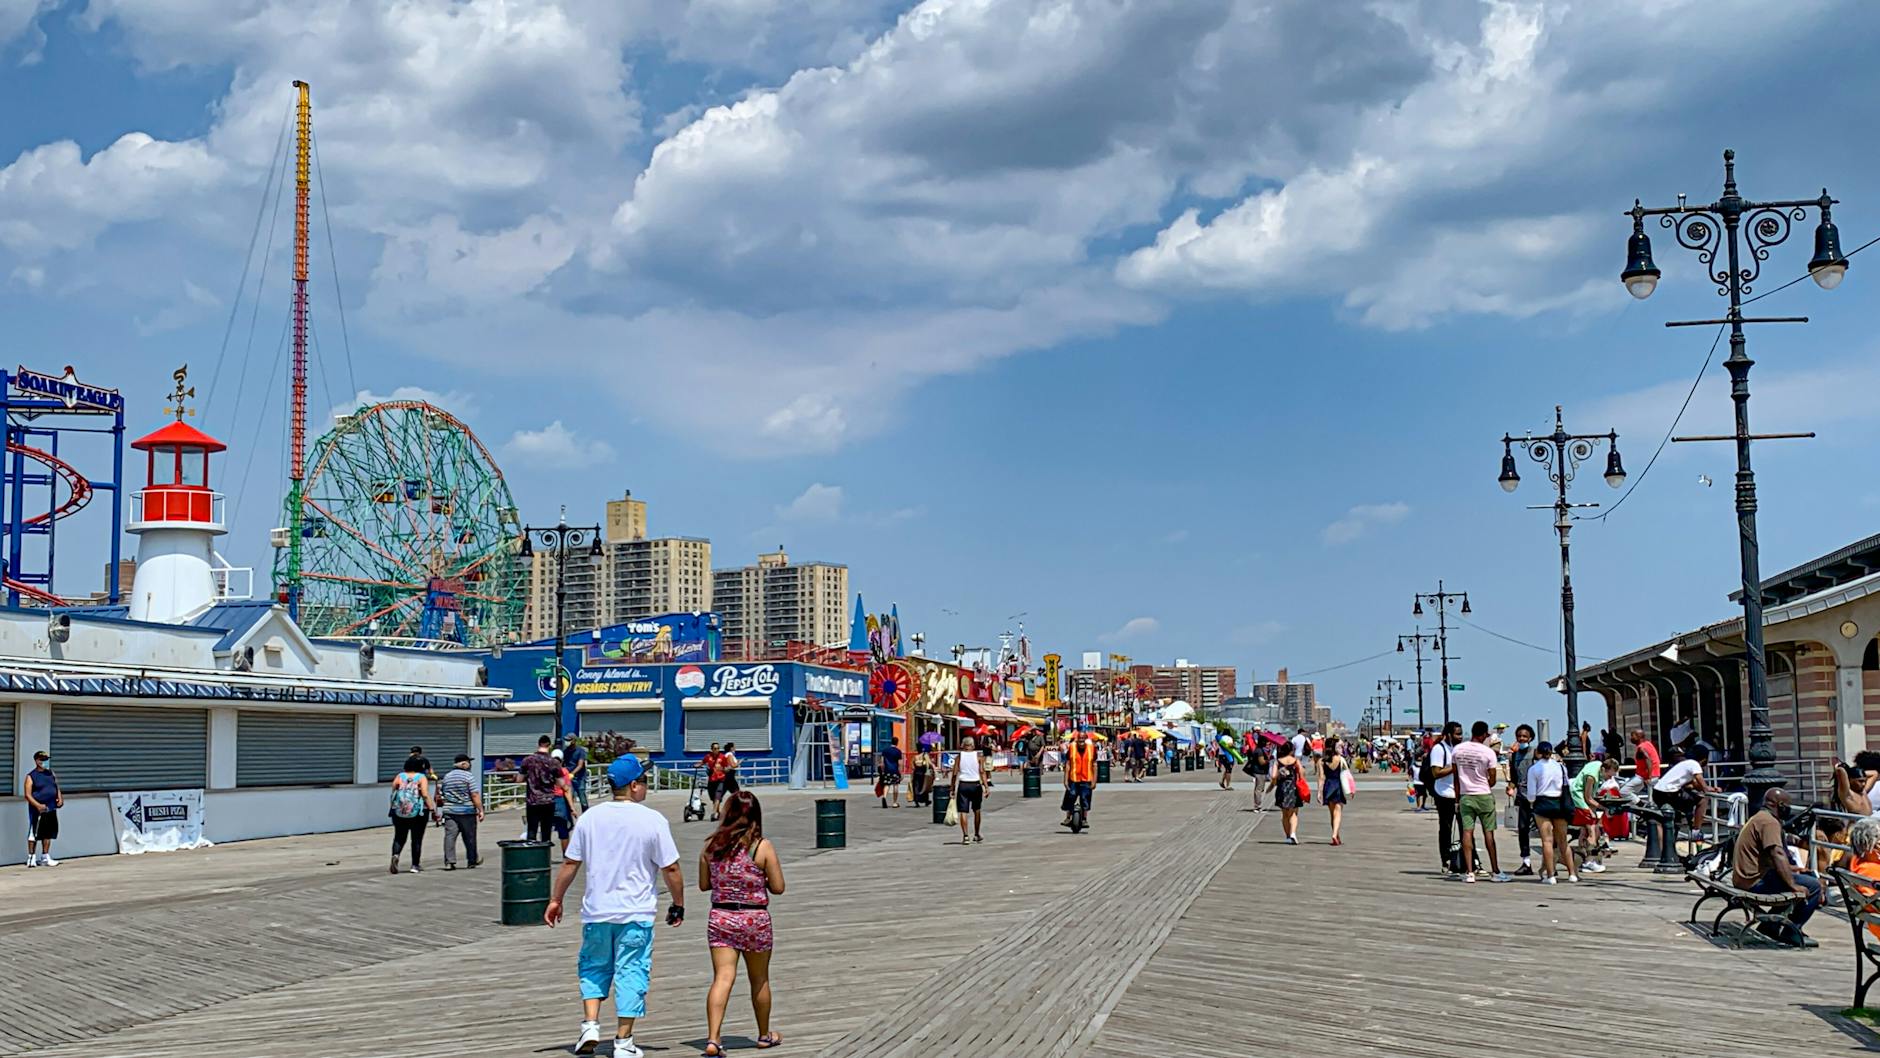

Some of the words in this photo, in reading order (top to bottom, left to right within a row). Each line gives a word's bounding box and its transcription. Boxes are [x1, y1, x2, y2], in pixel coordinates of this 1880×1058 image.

[576, 668, 602, 683] Coney
[603, 667, 632, 680] Island
[573, 683, 609, 694] COSMOS
[609, 681, 653, 693] COUNTRY!
